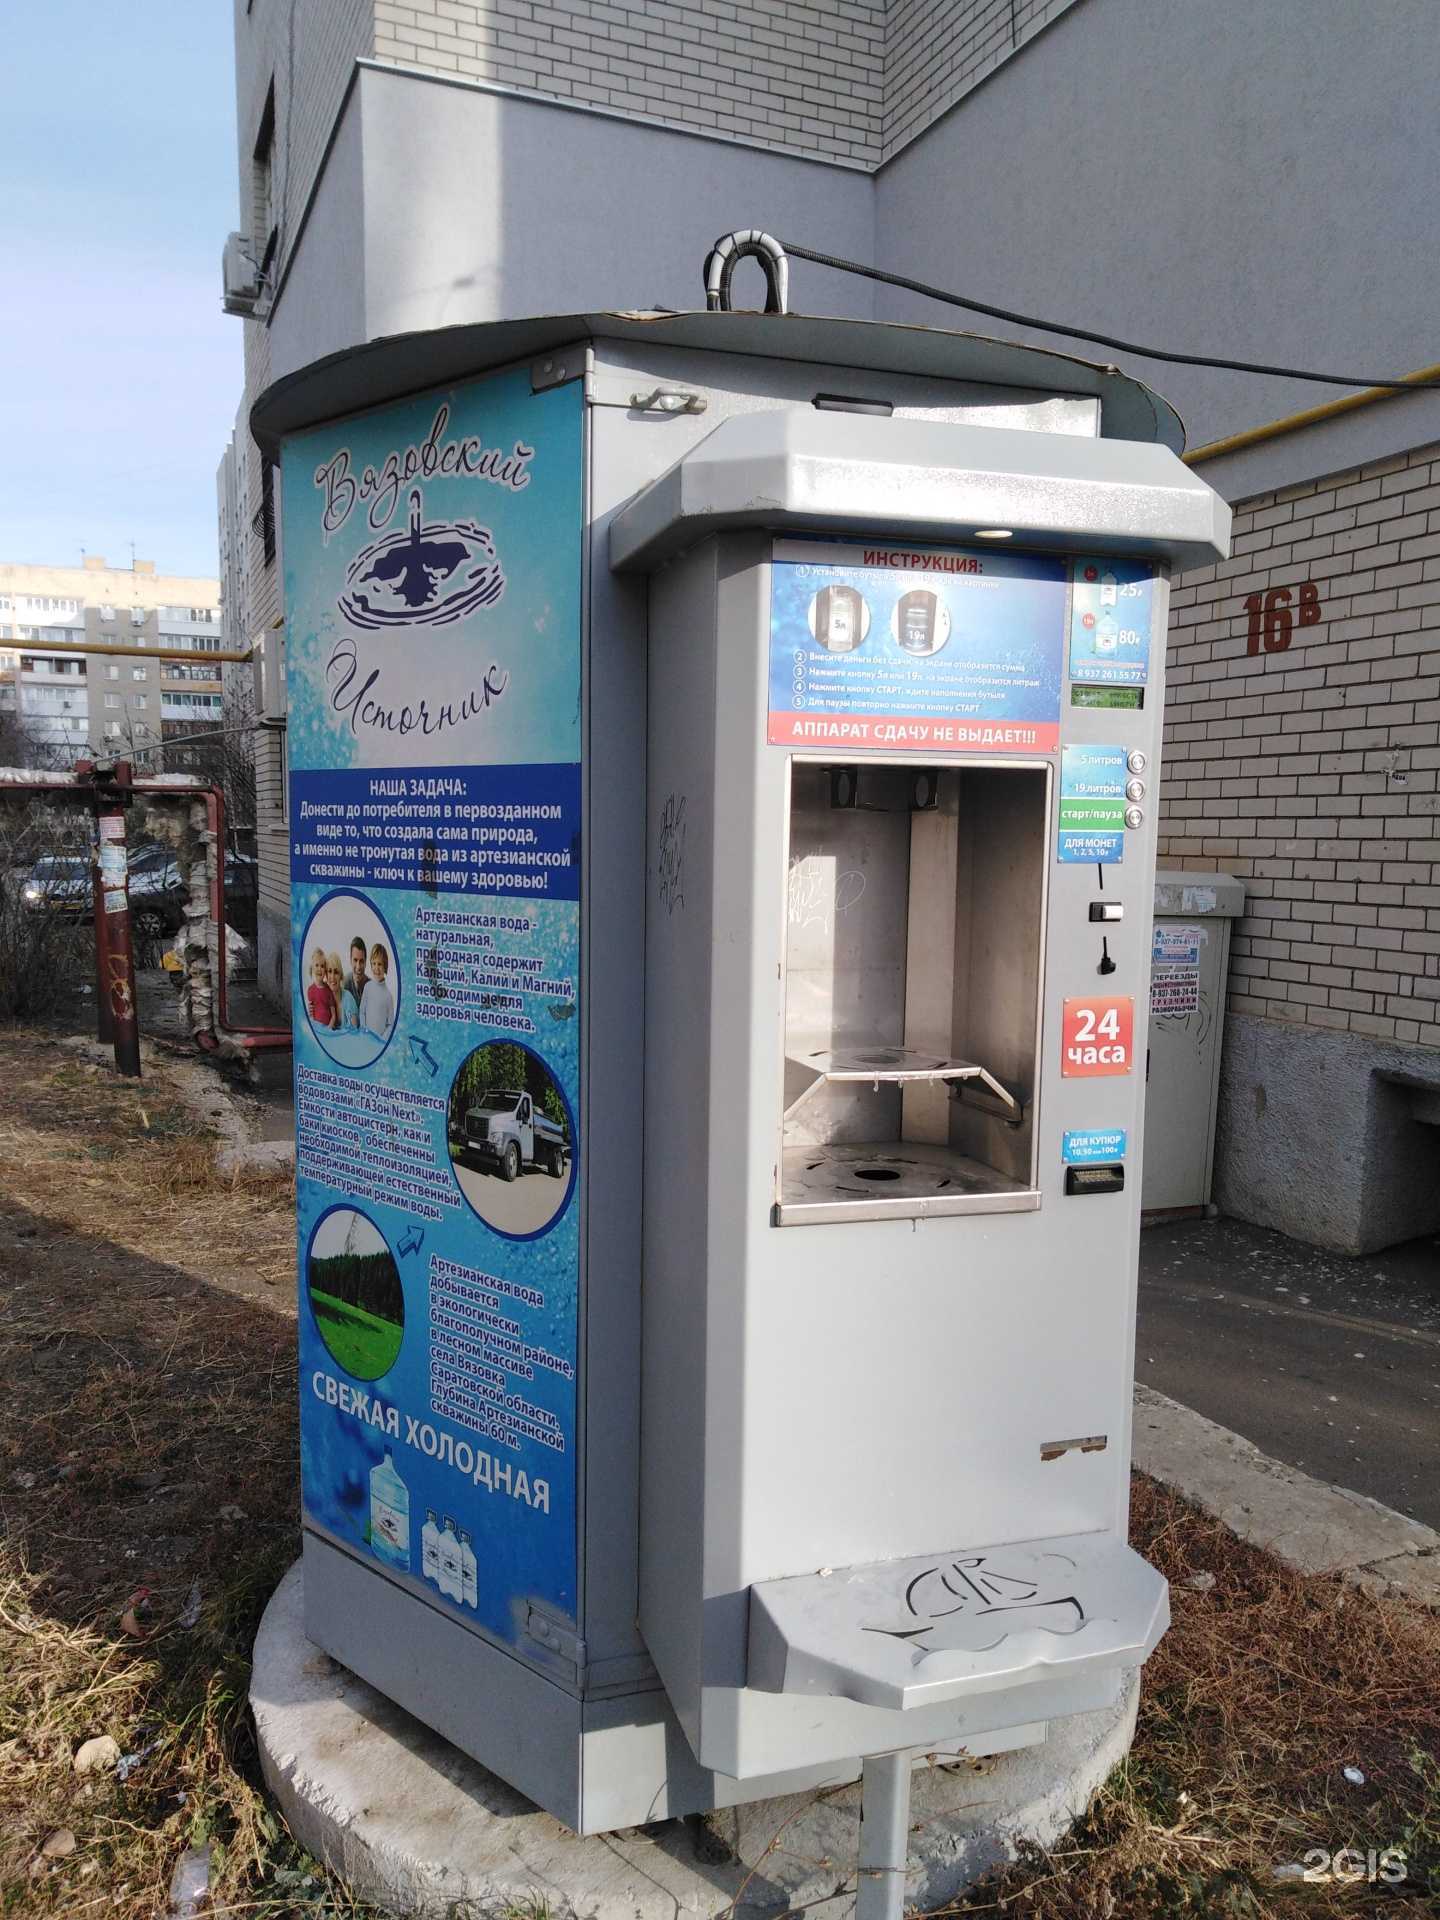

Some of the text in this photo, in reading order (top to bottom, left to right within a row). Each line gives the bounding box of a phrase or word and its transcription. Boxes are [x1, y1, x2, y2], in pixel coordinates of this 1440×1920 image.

[315, 405, 532, 535] Вязовский
[863, 550, 984, 574] ИНСТРУКЦИЯ:
[326, 638, 506, 735] Источник
[808, 682, 845, 692] Нажмите
[954, 704, 980, 713] СТАРТ
[791, 720, 1036, 744] АППАРАТ СДАЧУ НЕ ВЫДАЕТ!!!
[1088, 756, 1122, 766] литров
[370, 778, 467, 800] НАША ЗАДАЧА:
[1075, 784, 1122, 795] 19 литров
[300, 801, 562, 823] Донести до потребителя в первозданном
[1062, 809, 1123, 820] старт/пауза
[316, 824, 538, 846] виде то, что создала сама природа,
[1064, 838, 1117, 849] ДЛЯ МОНЕТ
[294, 843, 571, 868] а именно не тронутая вода из артезианской
[310, 864, 365, 878] скважины
[374, 867, 404, 880] ключ
[407, 868, 414, 881] к
[417, 869, 469, 889] вашему
[471, 871, 548, 891] здоровью!
[416, 907, 497, 928] Артезианская
[500, 917, 530, 932] вода
[416, 928, 495, 949] натуральная,
[416, 948, 544, 972] природная содержит
[416, 963, 577, 998] Кальций, Калий и Магний,
[416, 983, 523, 1011] необходимые для
[416, 1002, 536, 1032] здоровья человека.
[1074, 1008, 1120, 1042] 24
[1068, 1045, 1126, 1064] часа
[298, 1066, 445, 1111] Доставка воды осуществляется
[300, 1114, 435, 1163] баки киосков, обеспеченны
[337, 1108, 400, 1137] автоцистерн,
[404, 1126, 422, 1142] как
[1069, 1136, 1122, 1148] ДЛЯ КУПЮР
[300, 1132, 452, 1188] необходимой теплоизоляцией,
[300, 1150, 462, 1208] поддерживающей естественный
[300, 1165, 442, 1220] температурный режим воды.
[430, 1254, 544, 1306] Артезианская вода
[430, 1276, 499, 1308] добывается
[430, 1292, 520, 1335] в экологически
[430, 1308, 575, 1379] благополучном районе,
[430, 1330, 534, 1378] в лесном массиве
[430, 1347, 506, 1386] села Вязовка
[430, 1362, 560, 1428] Саратовской области.
[431, 1380, 564, 1450] Глубина Артезианской
[431, 1399, 522, 1451] скважины 60 м.
[312, 1371, 550, 1514] СВЕЖАЯ ХОЛОДНАЯ
